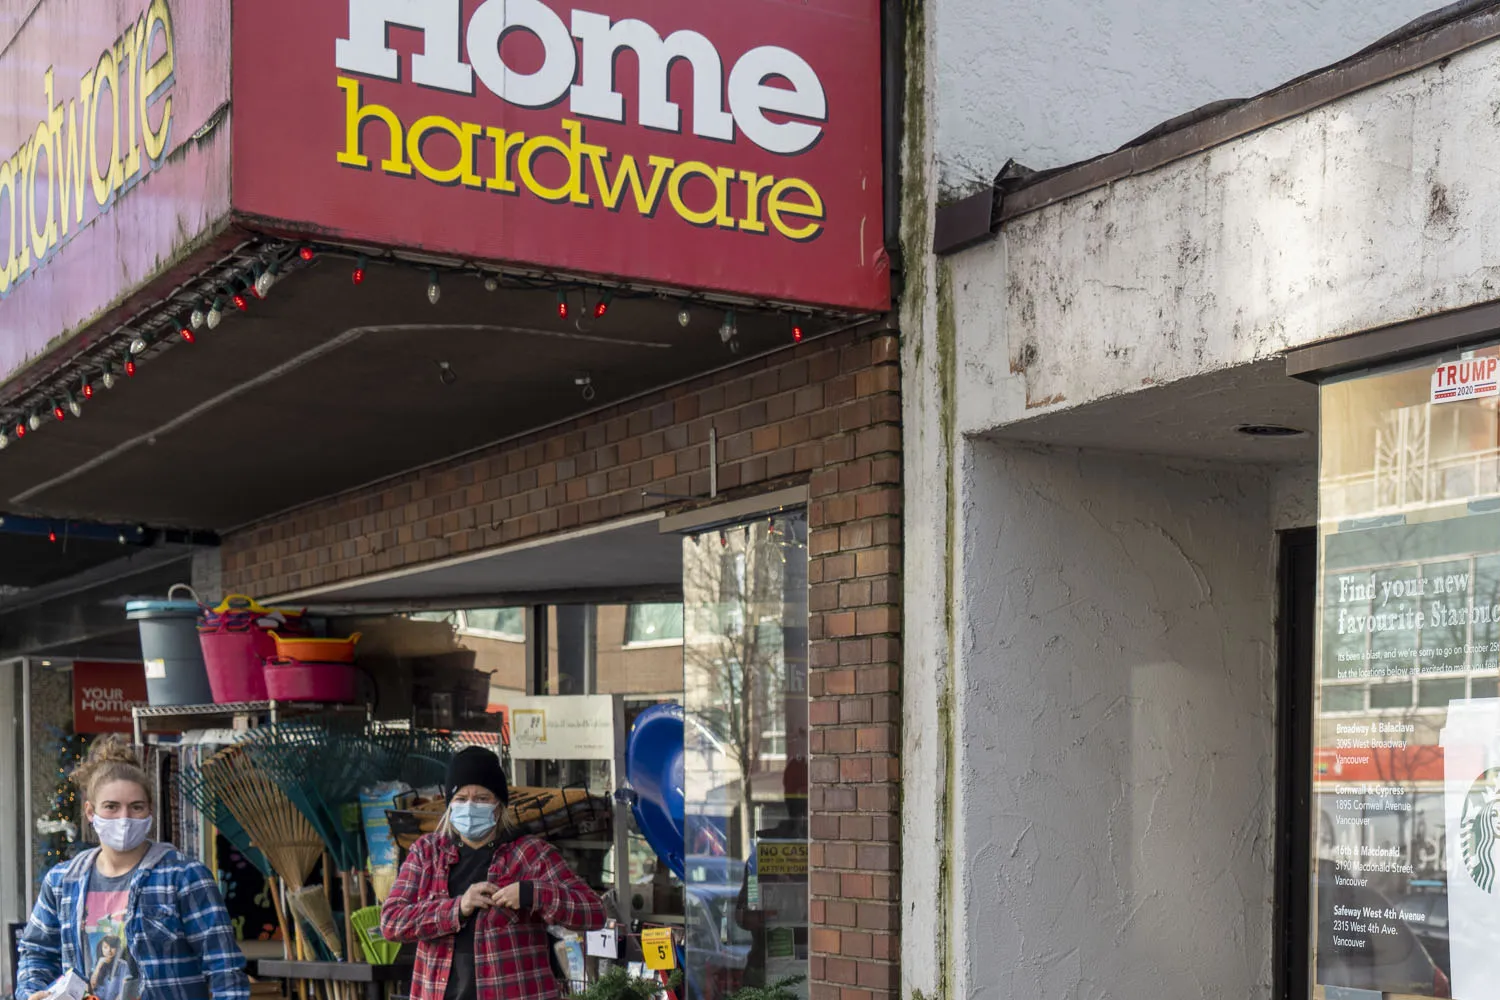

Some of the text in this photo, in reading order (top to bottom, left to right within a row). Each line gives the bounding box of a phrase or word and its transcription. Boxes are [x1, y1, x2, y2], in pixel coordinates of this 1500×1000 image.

[335, 0, 827, 154] Home
[0, 0, 175, 294] ardware
[336, 76, 824, 240] hardware
[1436, 358, 1498, 388] TRUMP
[1457, 385, 1474, 397] 2020
[1338, 572, 1469, 607] Find your new
[1337, 603, 1425, 635] favourite
[1346, 651, 1360, 662] been
[1383, 648, 1397, 659] and
[1419, 647, 1435, 659] sorry
[1436, 647, 1443, 656] to
[1443, 647, 1453, 658] go
[1454, 646, 1463, 655] on
[1463, 643, 1489, 654] October
[1337, 668, 1347, 679] but
[1348, 667, 1358, 678] the
[1359, 667, 1386, 678] locations
[1386, 665, 1408, 678] below
[1409, 667, 1421, 676] are
[1421, 663, 1445, 675] excited
[1445, 663, 1453, 673] to
[1471, 662, 1484, 673] you
[1485, 659, 1498, 670] feel
[82, 687, 124, 700] YOUR
[1336, 721, 1415, 736] Broadway & Balaclava
[1336, 738, 1407, 751] 3095 West Broadway
[1335, 754, 1369, 765] Vancouver
[1334, 784, 1405, 798] Cornwall & Cypress
[1335, 799, 1412, 812] 1895 Cornwall Avenue
[1335, 814, 1370, 826] Vancouver
[760, 846, 778, 857] NO
[1336, 844, 1352, 857] 16th
[1360, 845, 1400, 857] Macdonald
[1335, 860, 1414, 874] 3190 Macdonald Street
[1334, 874, 1368, 887] Vancouver
[1333, 904, 1426, 922] Safeway West 4th Avenue
[1333, 919, 1399, 935] 2315 West 4th Ave.
[1332, 935, 1366, 948] Vancouver
